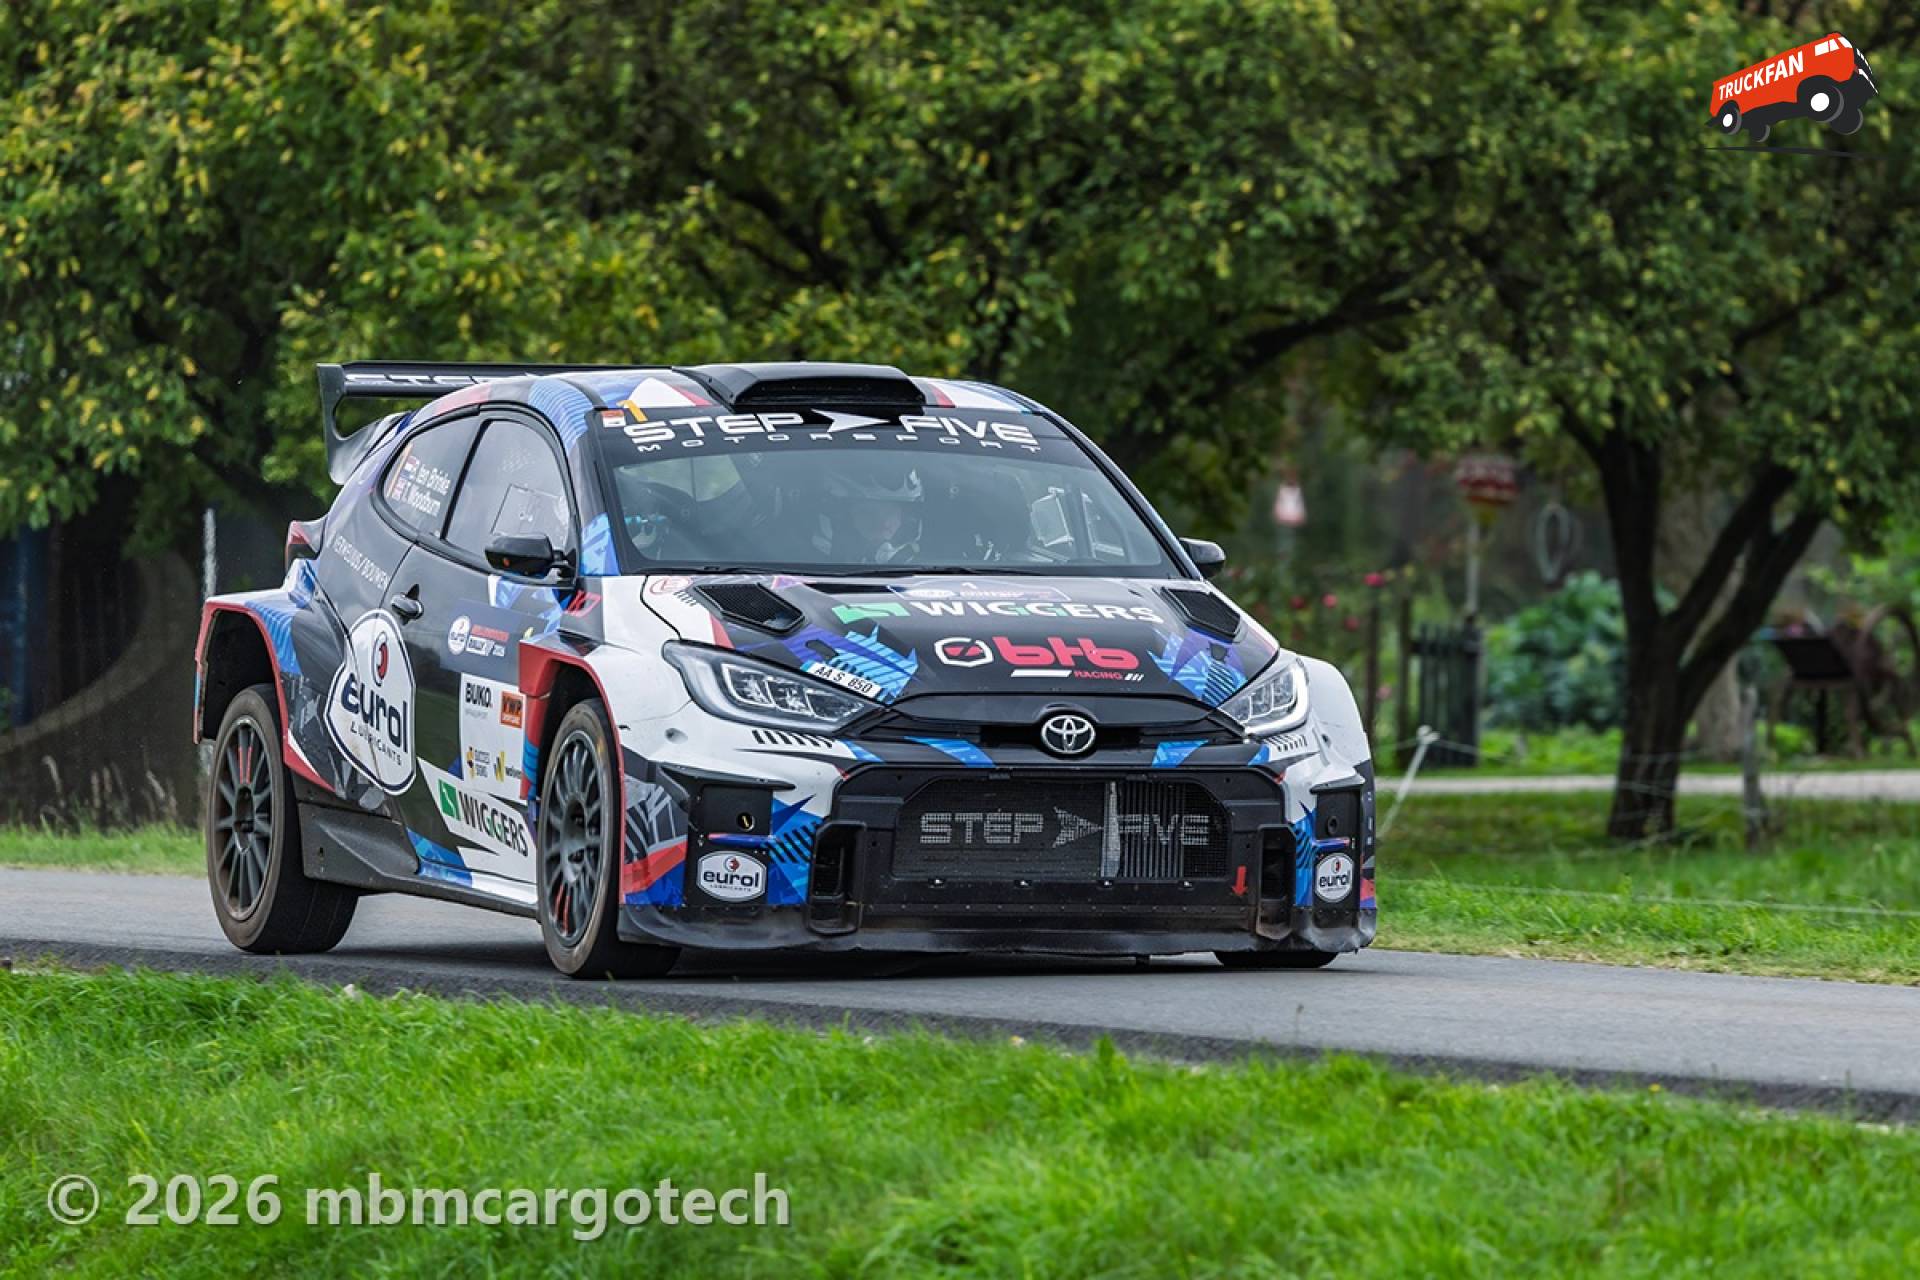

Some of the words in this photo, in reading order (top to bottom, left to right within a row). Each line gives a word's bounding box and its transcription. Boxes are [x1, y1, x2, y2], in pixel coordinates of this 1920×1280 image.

[623, 412, 804, 444] STEP
[899, 415, 1038, 446] FIVE
[637, 433, 1041, 453] MOTORSPORT
[909, 600, 1165, 624] WIGGERS
[1073, 670, 1123, 681] RACING
[340, 672, 408, 754] eurol
[458, 790, 529, 857] WIGGERS
[920, 812, 1044, 844] STEP
[1113, 814, 1209, 845] FIVE
[703, 870, 759, 888] eurol
[1319, 869, 1351, 887] eurol
